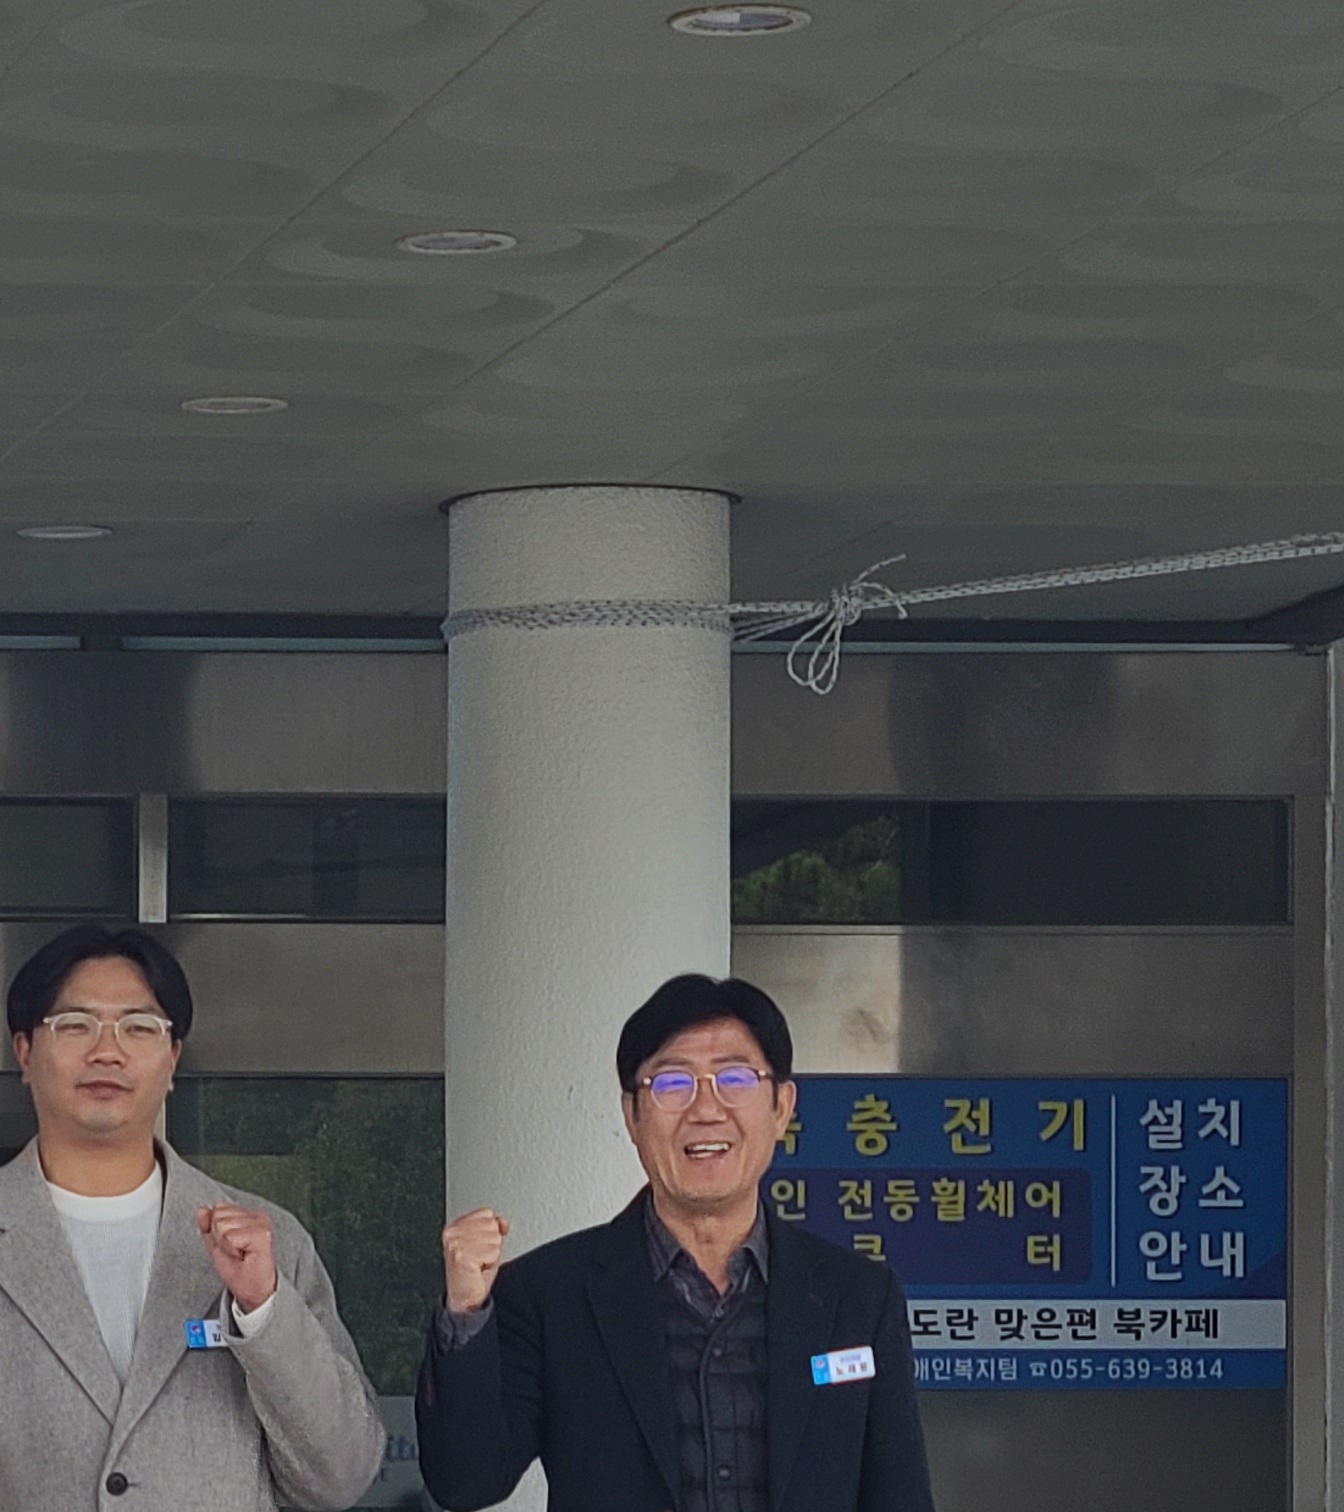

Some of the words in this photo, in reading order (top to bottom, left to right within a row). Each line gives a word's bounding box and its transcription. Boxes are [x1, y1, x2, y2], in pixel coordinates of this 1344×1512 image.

[1140, 1098, 1241, 1149] 설치
[838, 1179, 1061, 1222] 전동휠체어
[1140, 1166, 1244, 1217] 장소
[1140, 1230, 1246, 1281] 안내
[994, 1306, 1098, 1341] 맞은편
[1114, 1307, 1219, 1340] 북카페
